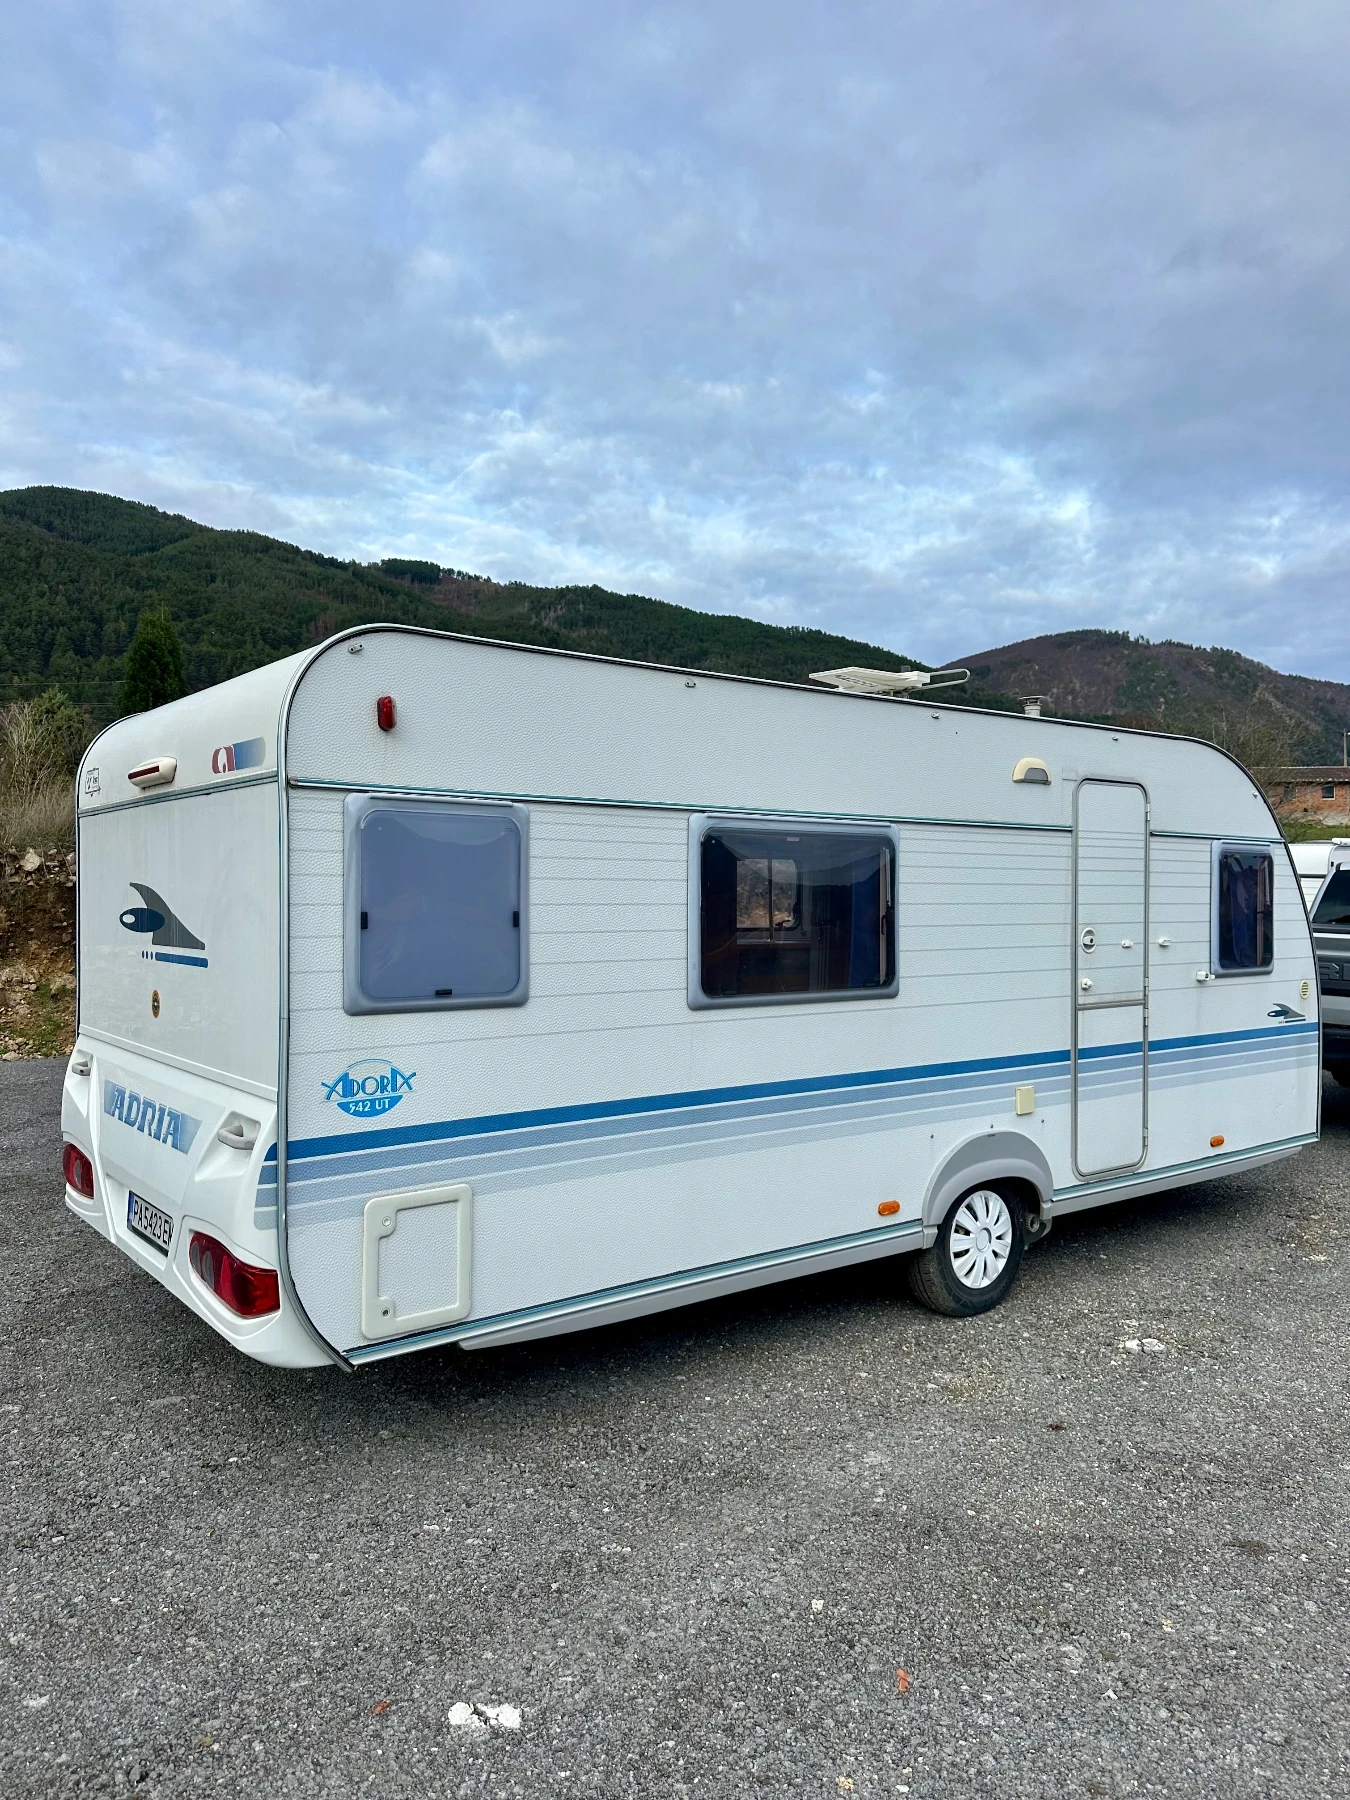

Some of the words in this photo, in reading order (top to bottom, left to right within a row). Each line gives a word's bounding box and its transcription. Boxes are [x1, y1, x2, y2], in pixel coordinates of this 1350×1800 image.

[110, 1084, 182, 1151] ADRIA
[349, 1101, 371, 1114] 542
[375, 1098, 391, 1111] UT
